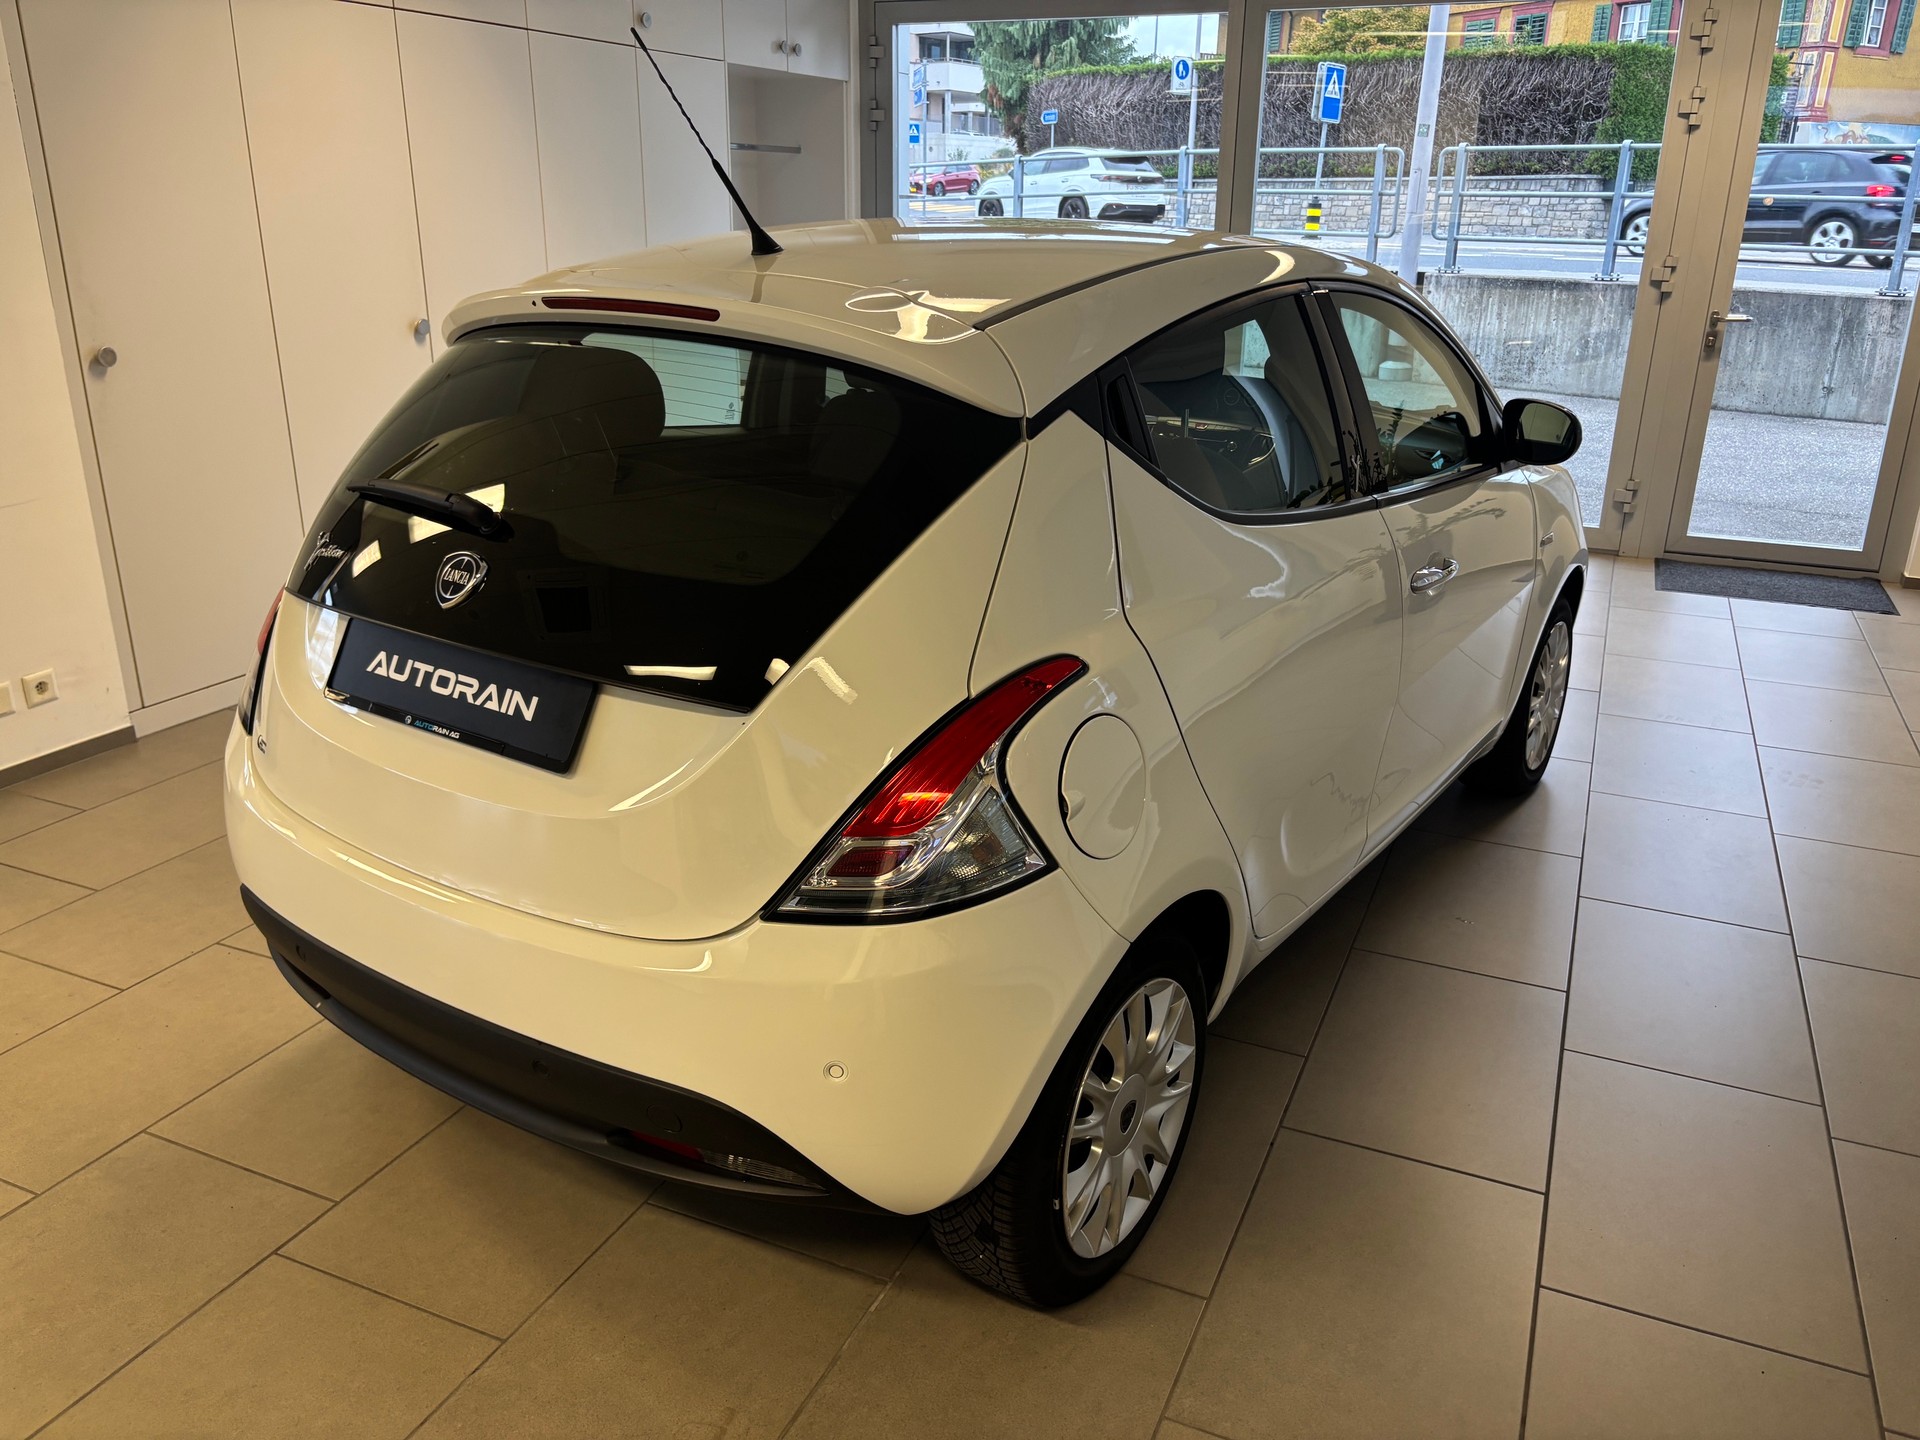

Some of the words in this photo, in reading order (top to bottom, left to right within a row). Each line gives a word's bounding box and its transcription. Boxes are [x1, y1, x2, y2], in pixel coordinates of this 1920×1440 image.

[443, 568, 470, 586] LANCIA
[366, 651, 539, 722] AUTORAIN
[414, 720, 450, 736] AUTORAIN
[449, 731, 460, 739] AG
